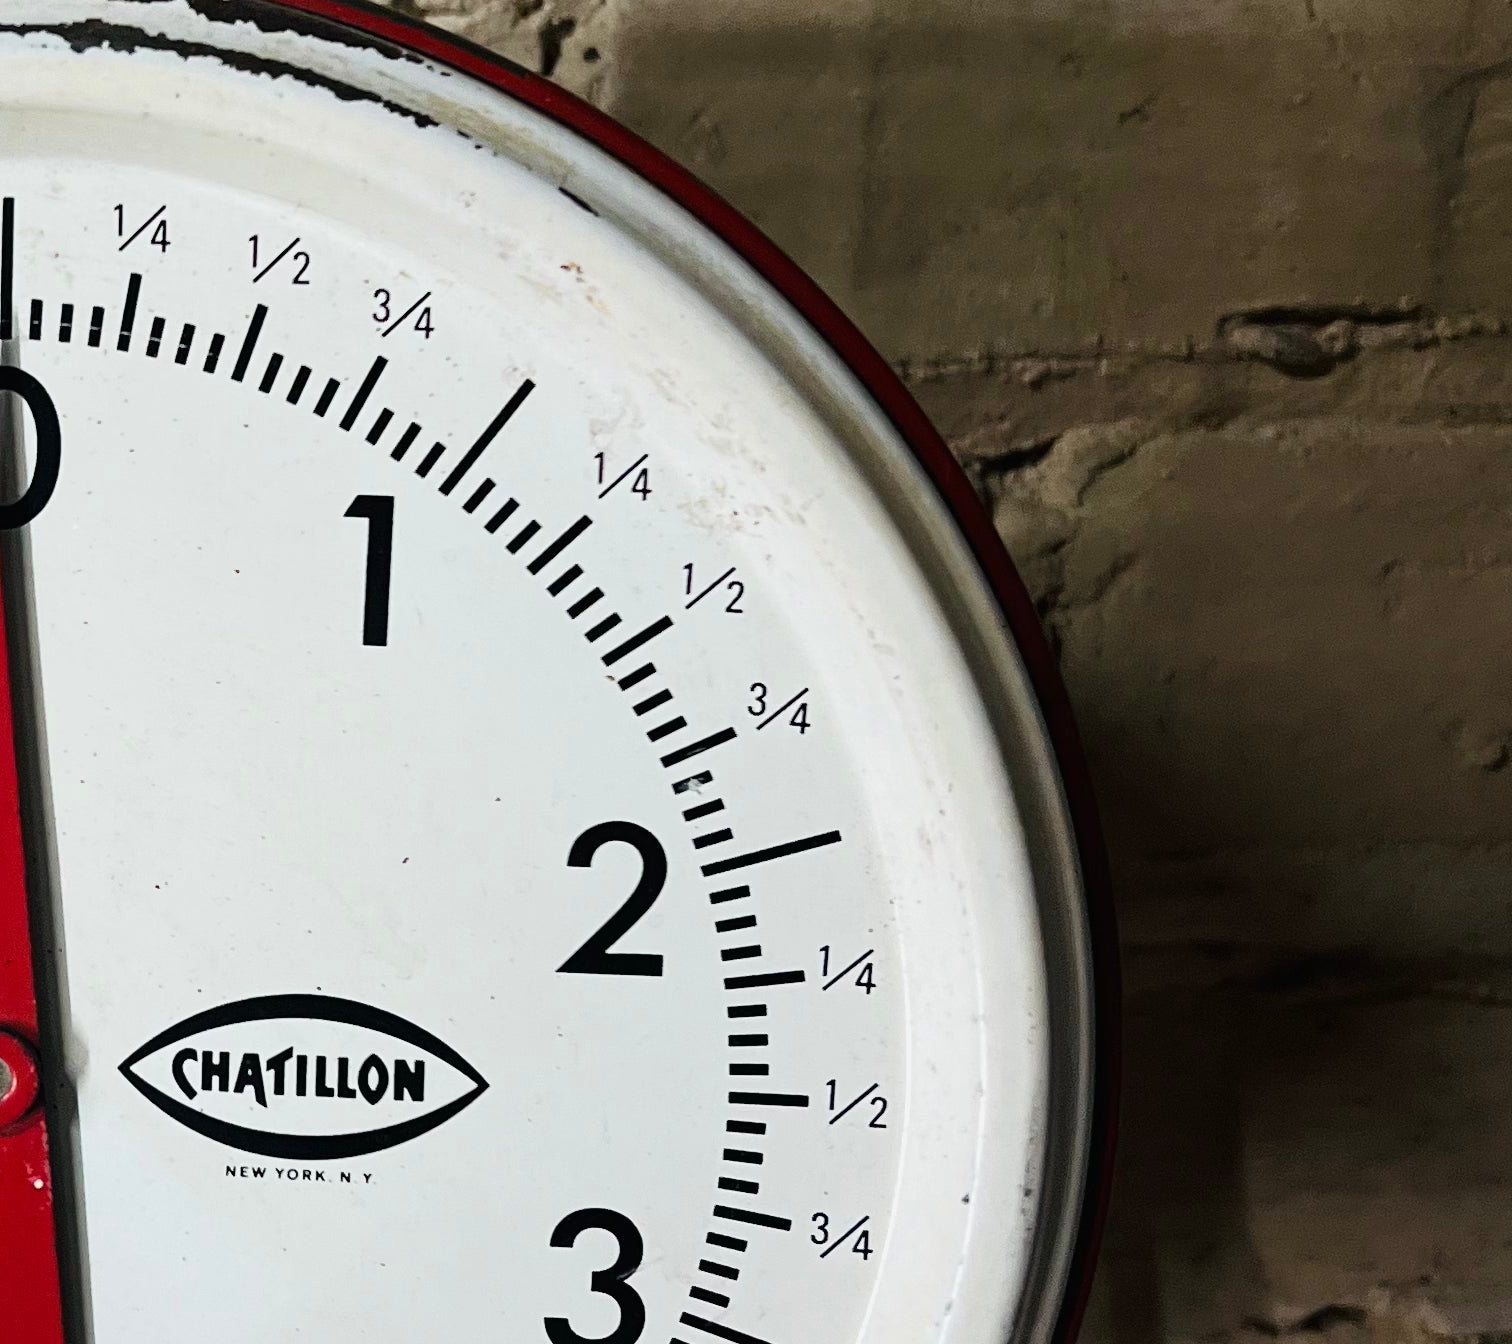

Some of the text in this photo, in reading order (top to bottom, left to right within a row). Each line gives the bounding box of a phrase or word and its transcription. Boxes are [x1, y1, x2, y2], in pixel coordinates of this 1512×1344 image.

[114, 204, 171, 253] 1/4
[249, 234, 310, 285] 1/2
[372, 288, 435, 339] 3/4
[594, 452, 652, 501] 1/4
[343, 495, 395, 647] 1
[683, 563, 744, 613] 1/2
[748, 683, 811, 734] 3/4
[555, 821, 667, 977] 2
[820, 945, 876, 994] 1/4
[172, 1046, 425, 1108] CHATILLON
[826, 1079, 887, 1128] 1/2
[226, 1166, 266, 1178] NEW
[811, 1212, 873, 1260] 3/4
